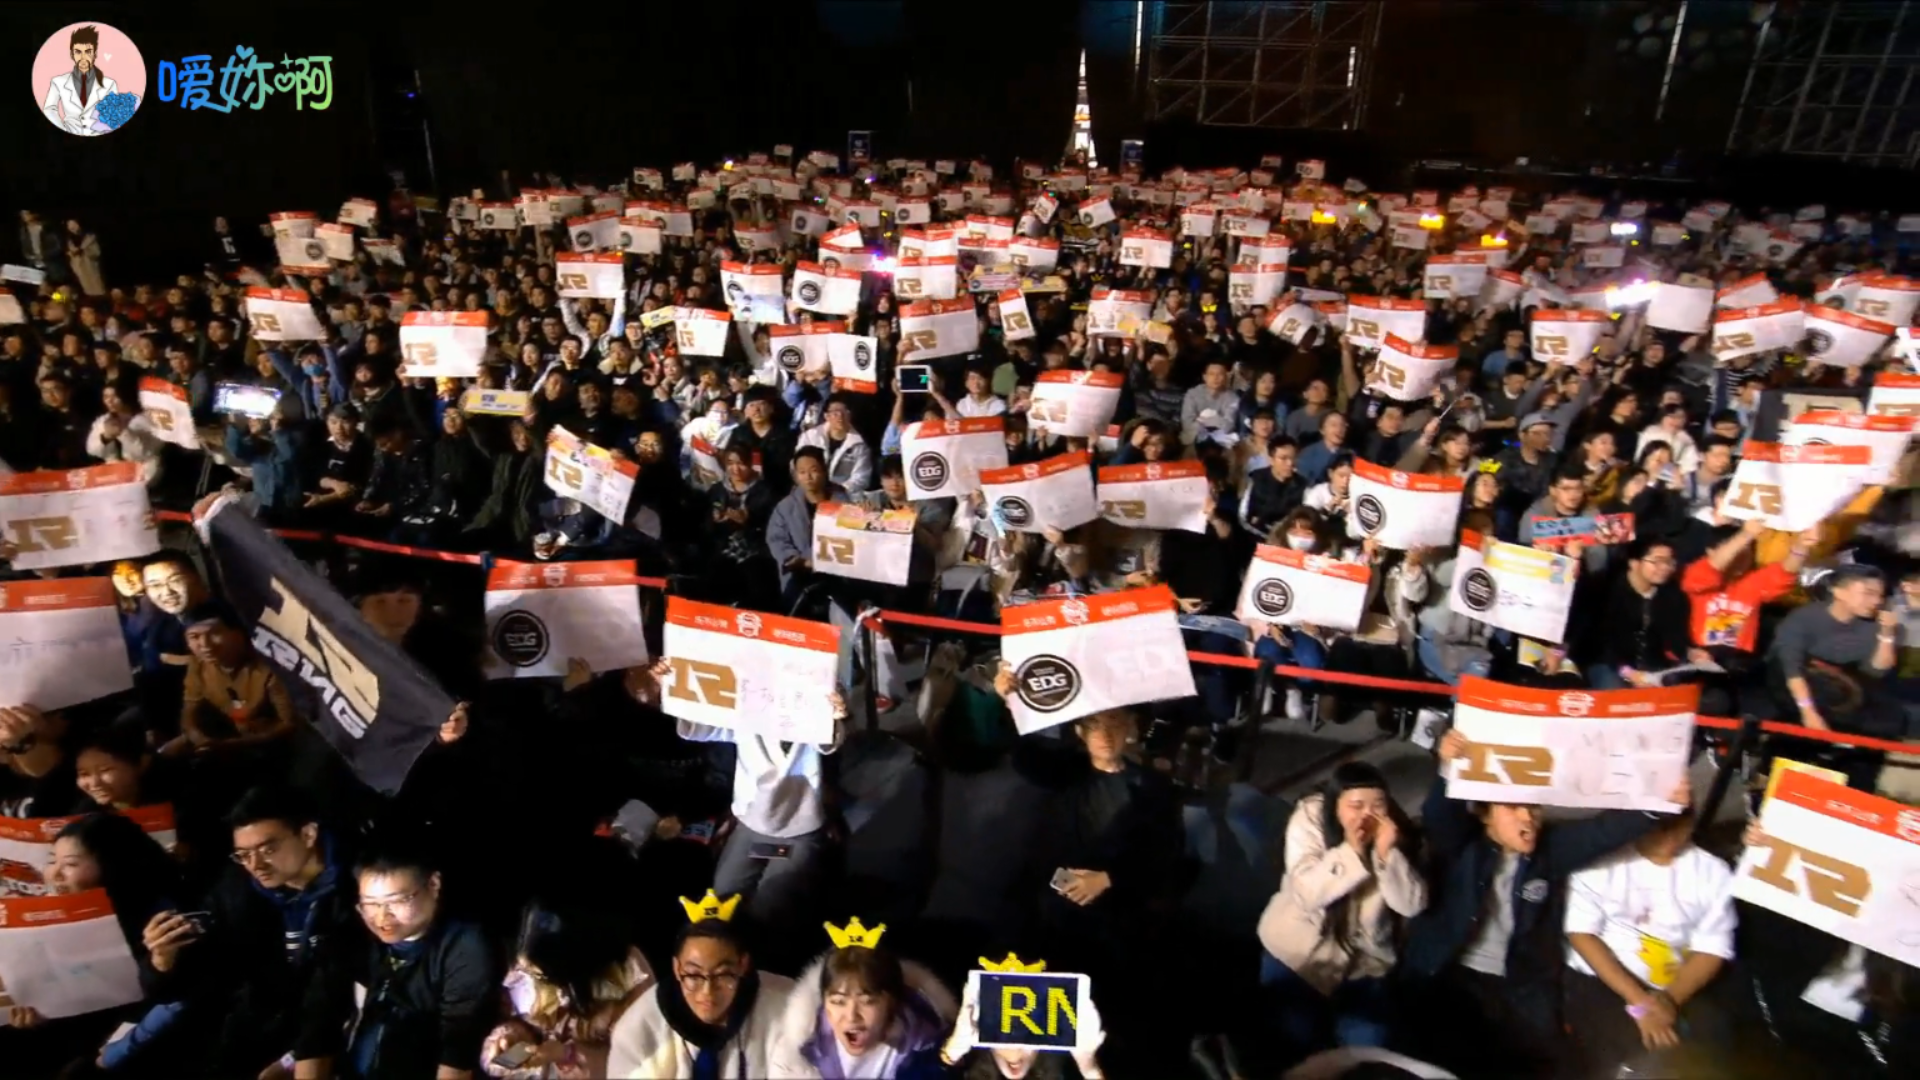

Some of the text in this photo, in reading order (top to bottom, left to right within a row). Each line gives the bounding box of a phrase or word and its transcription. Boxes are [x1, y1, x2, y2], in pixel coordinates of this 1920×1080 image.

[918, 466, 942, 478] EDG
[1261, 591, 1286, 606] EDG
[504, 632, 538, 647] EDG
[251, 626, 368, 739] RNG
[1027, 673, 1067, 692] EDG
